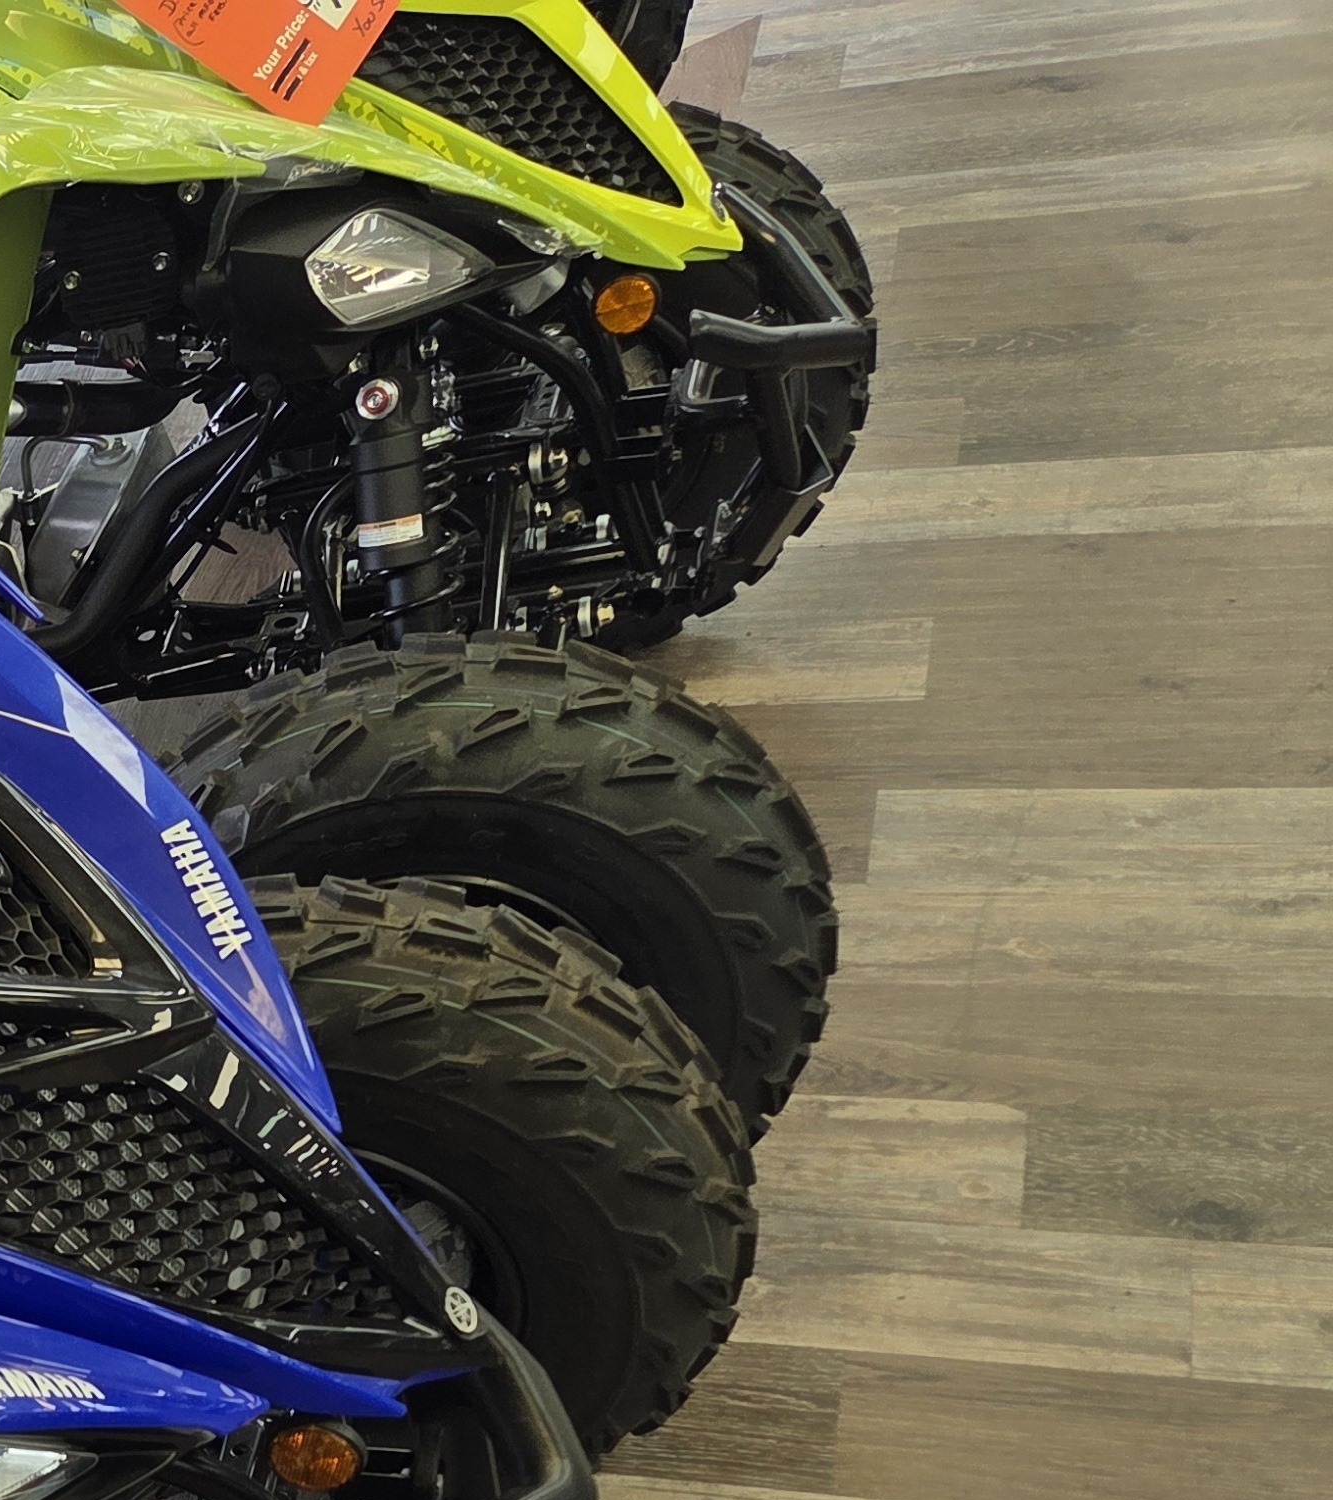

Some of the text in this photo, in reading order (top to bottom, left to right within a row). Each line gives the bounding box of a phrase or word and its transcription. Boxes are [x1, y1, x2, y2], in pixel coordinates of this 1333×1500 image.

[253, 48, 282, 80] Your
[275, 9, 310, 50] Price:
[161, 819, 253, 960] YAMAHA
